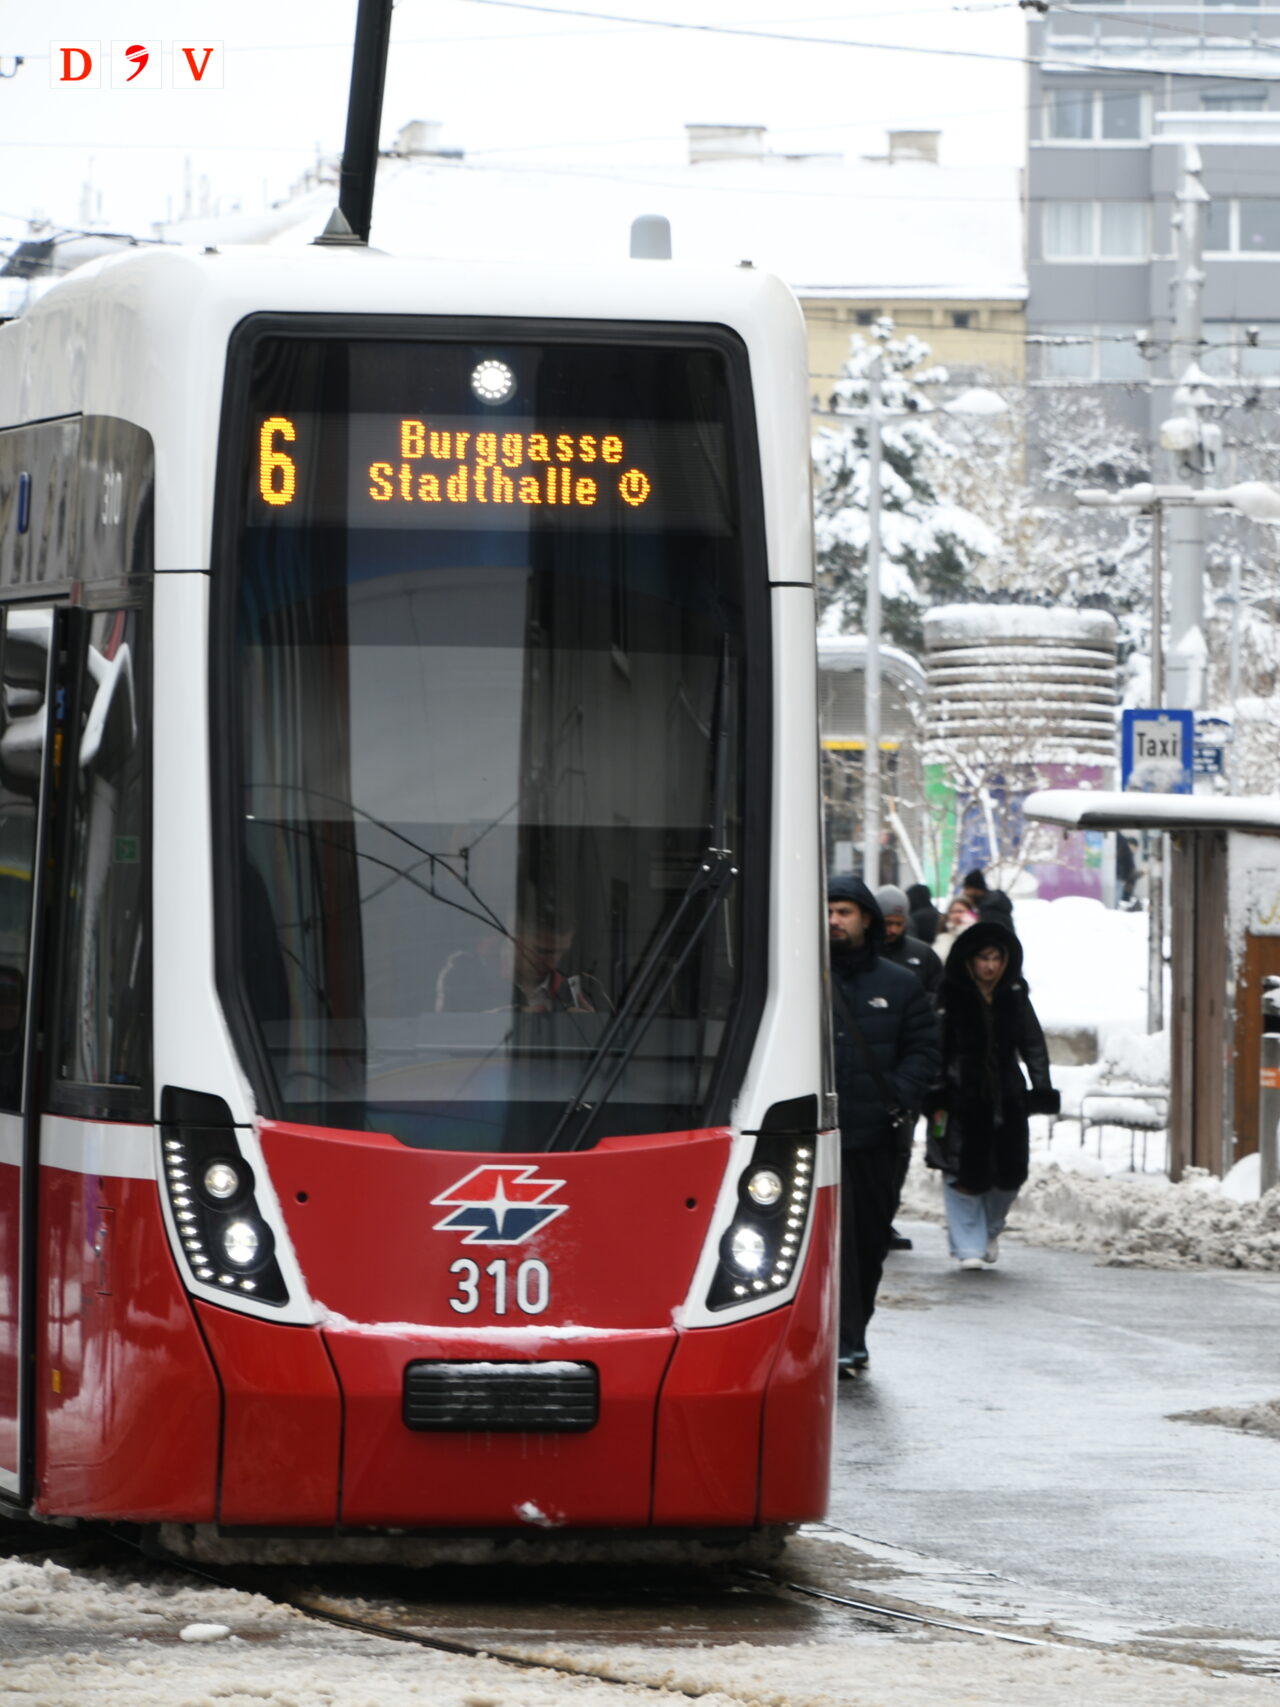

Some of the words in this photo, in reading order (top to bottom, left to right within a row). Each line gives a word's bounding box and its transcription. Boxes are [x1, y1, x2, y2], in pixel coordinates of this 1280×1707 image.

[259, 417, 296, 506] 6
[401, 419, 623, 468] Burggasse
[369, 462, 597, 505] Stadthalle
[1136, 732, 1178, 758] Taxi
[449, 1258, 550, 1315] 310
